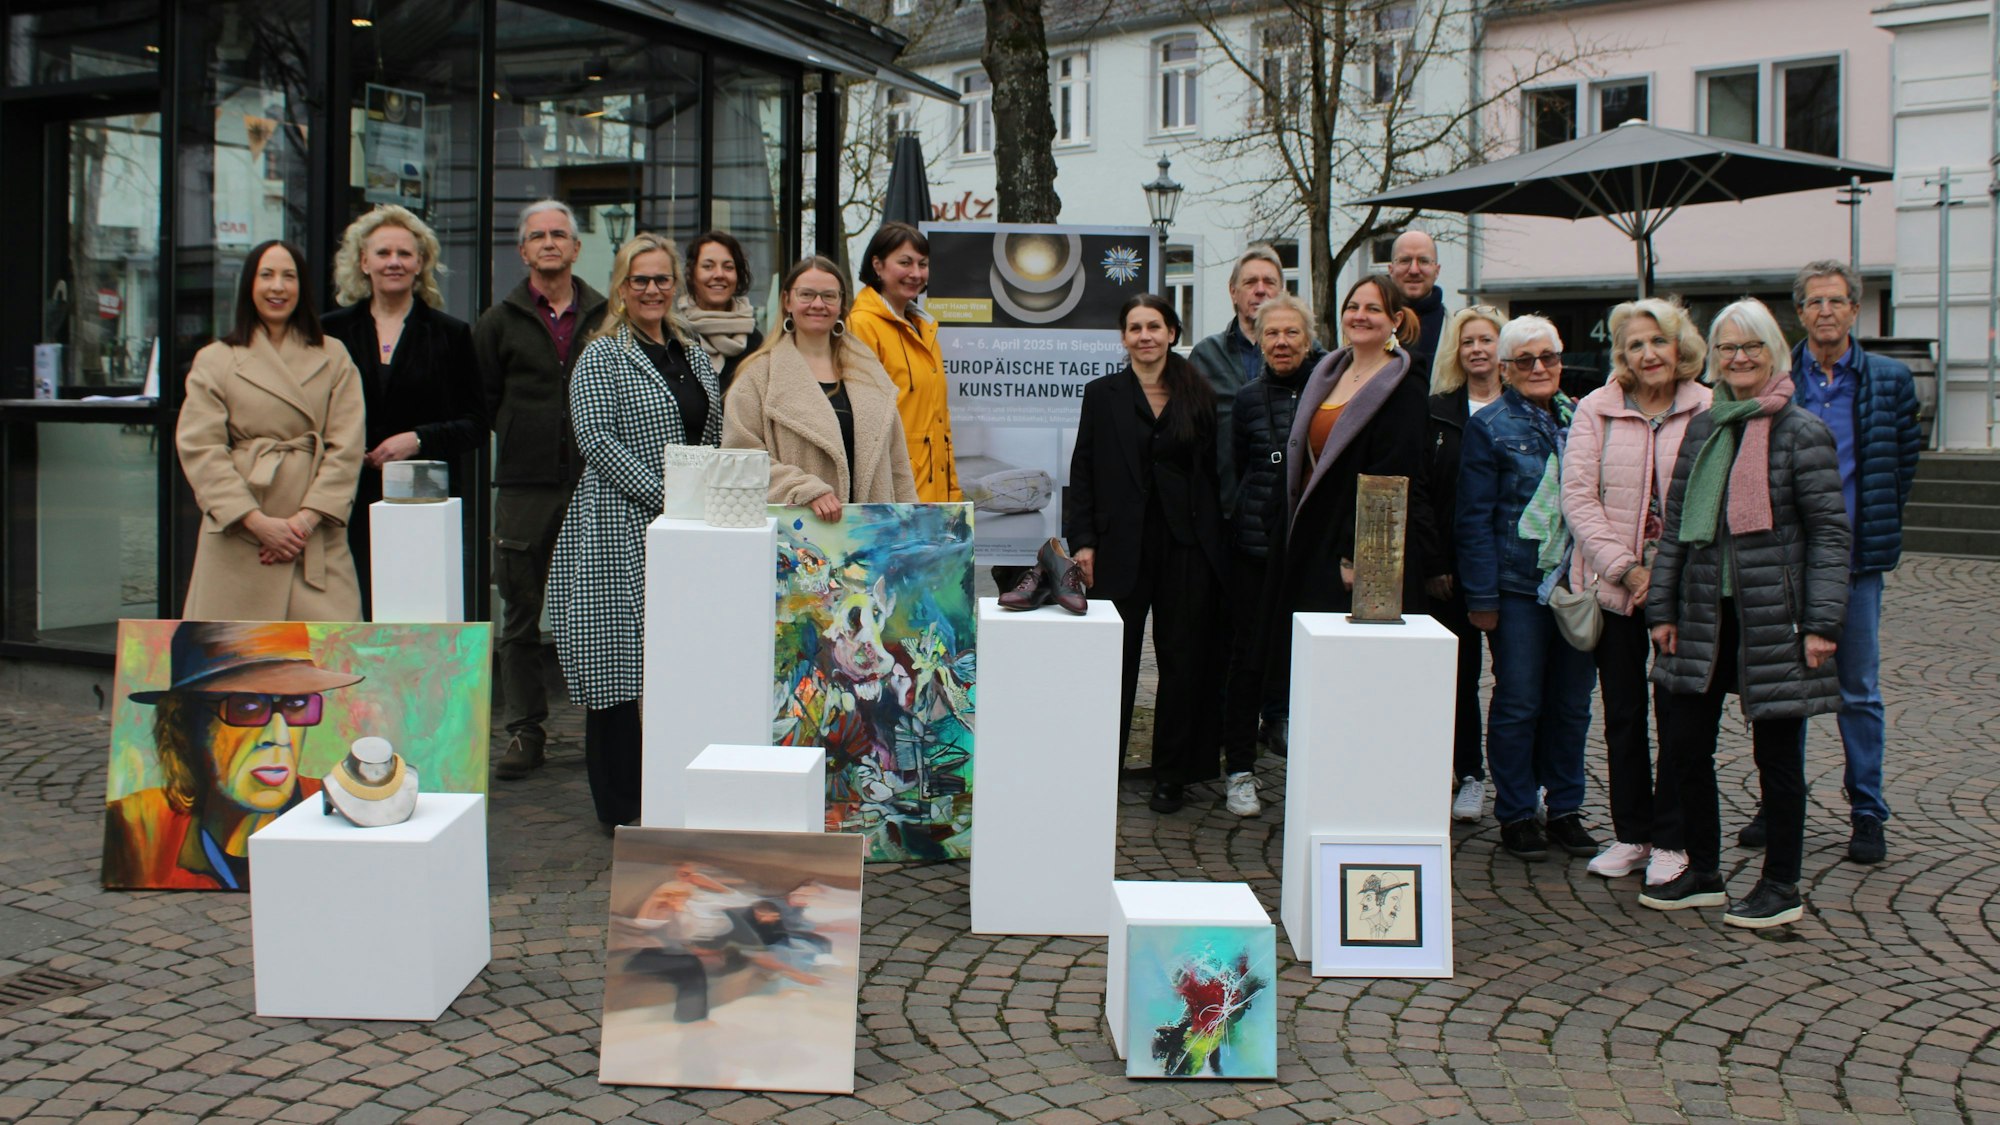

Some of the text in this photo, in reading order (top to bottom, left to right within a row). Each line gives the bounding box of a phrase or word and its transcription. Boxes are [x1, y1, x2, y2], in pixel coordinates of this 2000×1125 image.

[952, 338, 963, 349] 4.
[977, 339, 988, 350] 6.
[992, 338, 1020, 356] April
[1024, 339, 1053, 351] 2025
[1057, 339, 1068, 351] in
[942, 358, 1125, 376] EUROPÄISCHE TAGE DE
[959, 382, 1085, 398] KUNSTHANDWE
